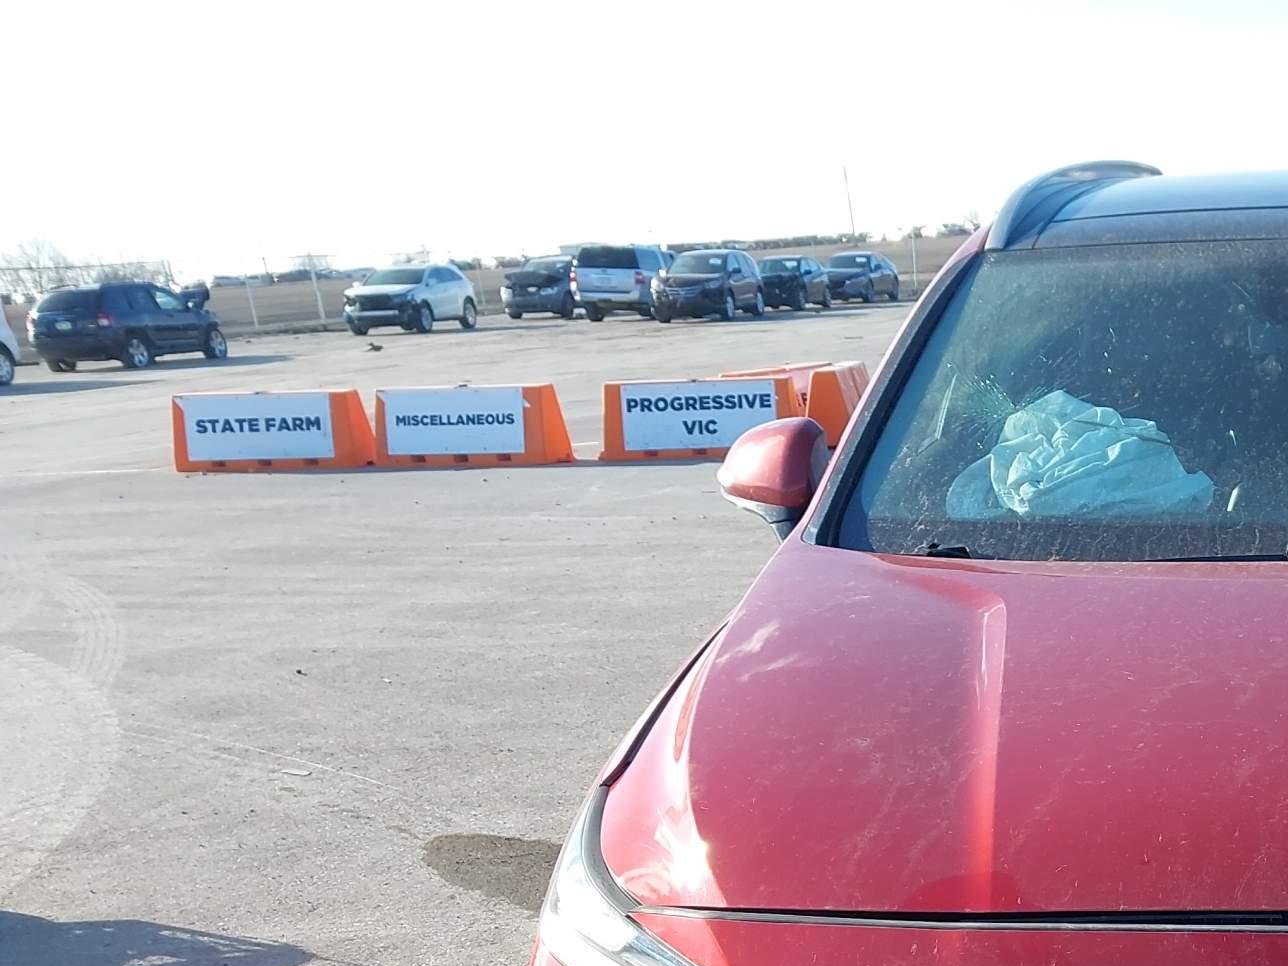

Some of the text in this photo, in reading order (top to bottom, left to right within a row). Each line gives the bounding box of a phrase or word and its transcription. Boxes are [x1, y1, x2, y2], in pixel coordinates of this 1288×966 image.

[625, 392, 772, 413] PROGRESSIVE
[195, 416, 322, 434] STATE FARM
[395, 412, 515, 427] MISCELLANEOUS
[682, 419, 719, 436] VIC
